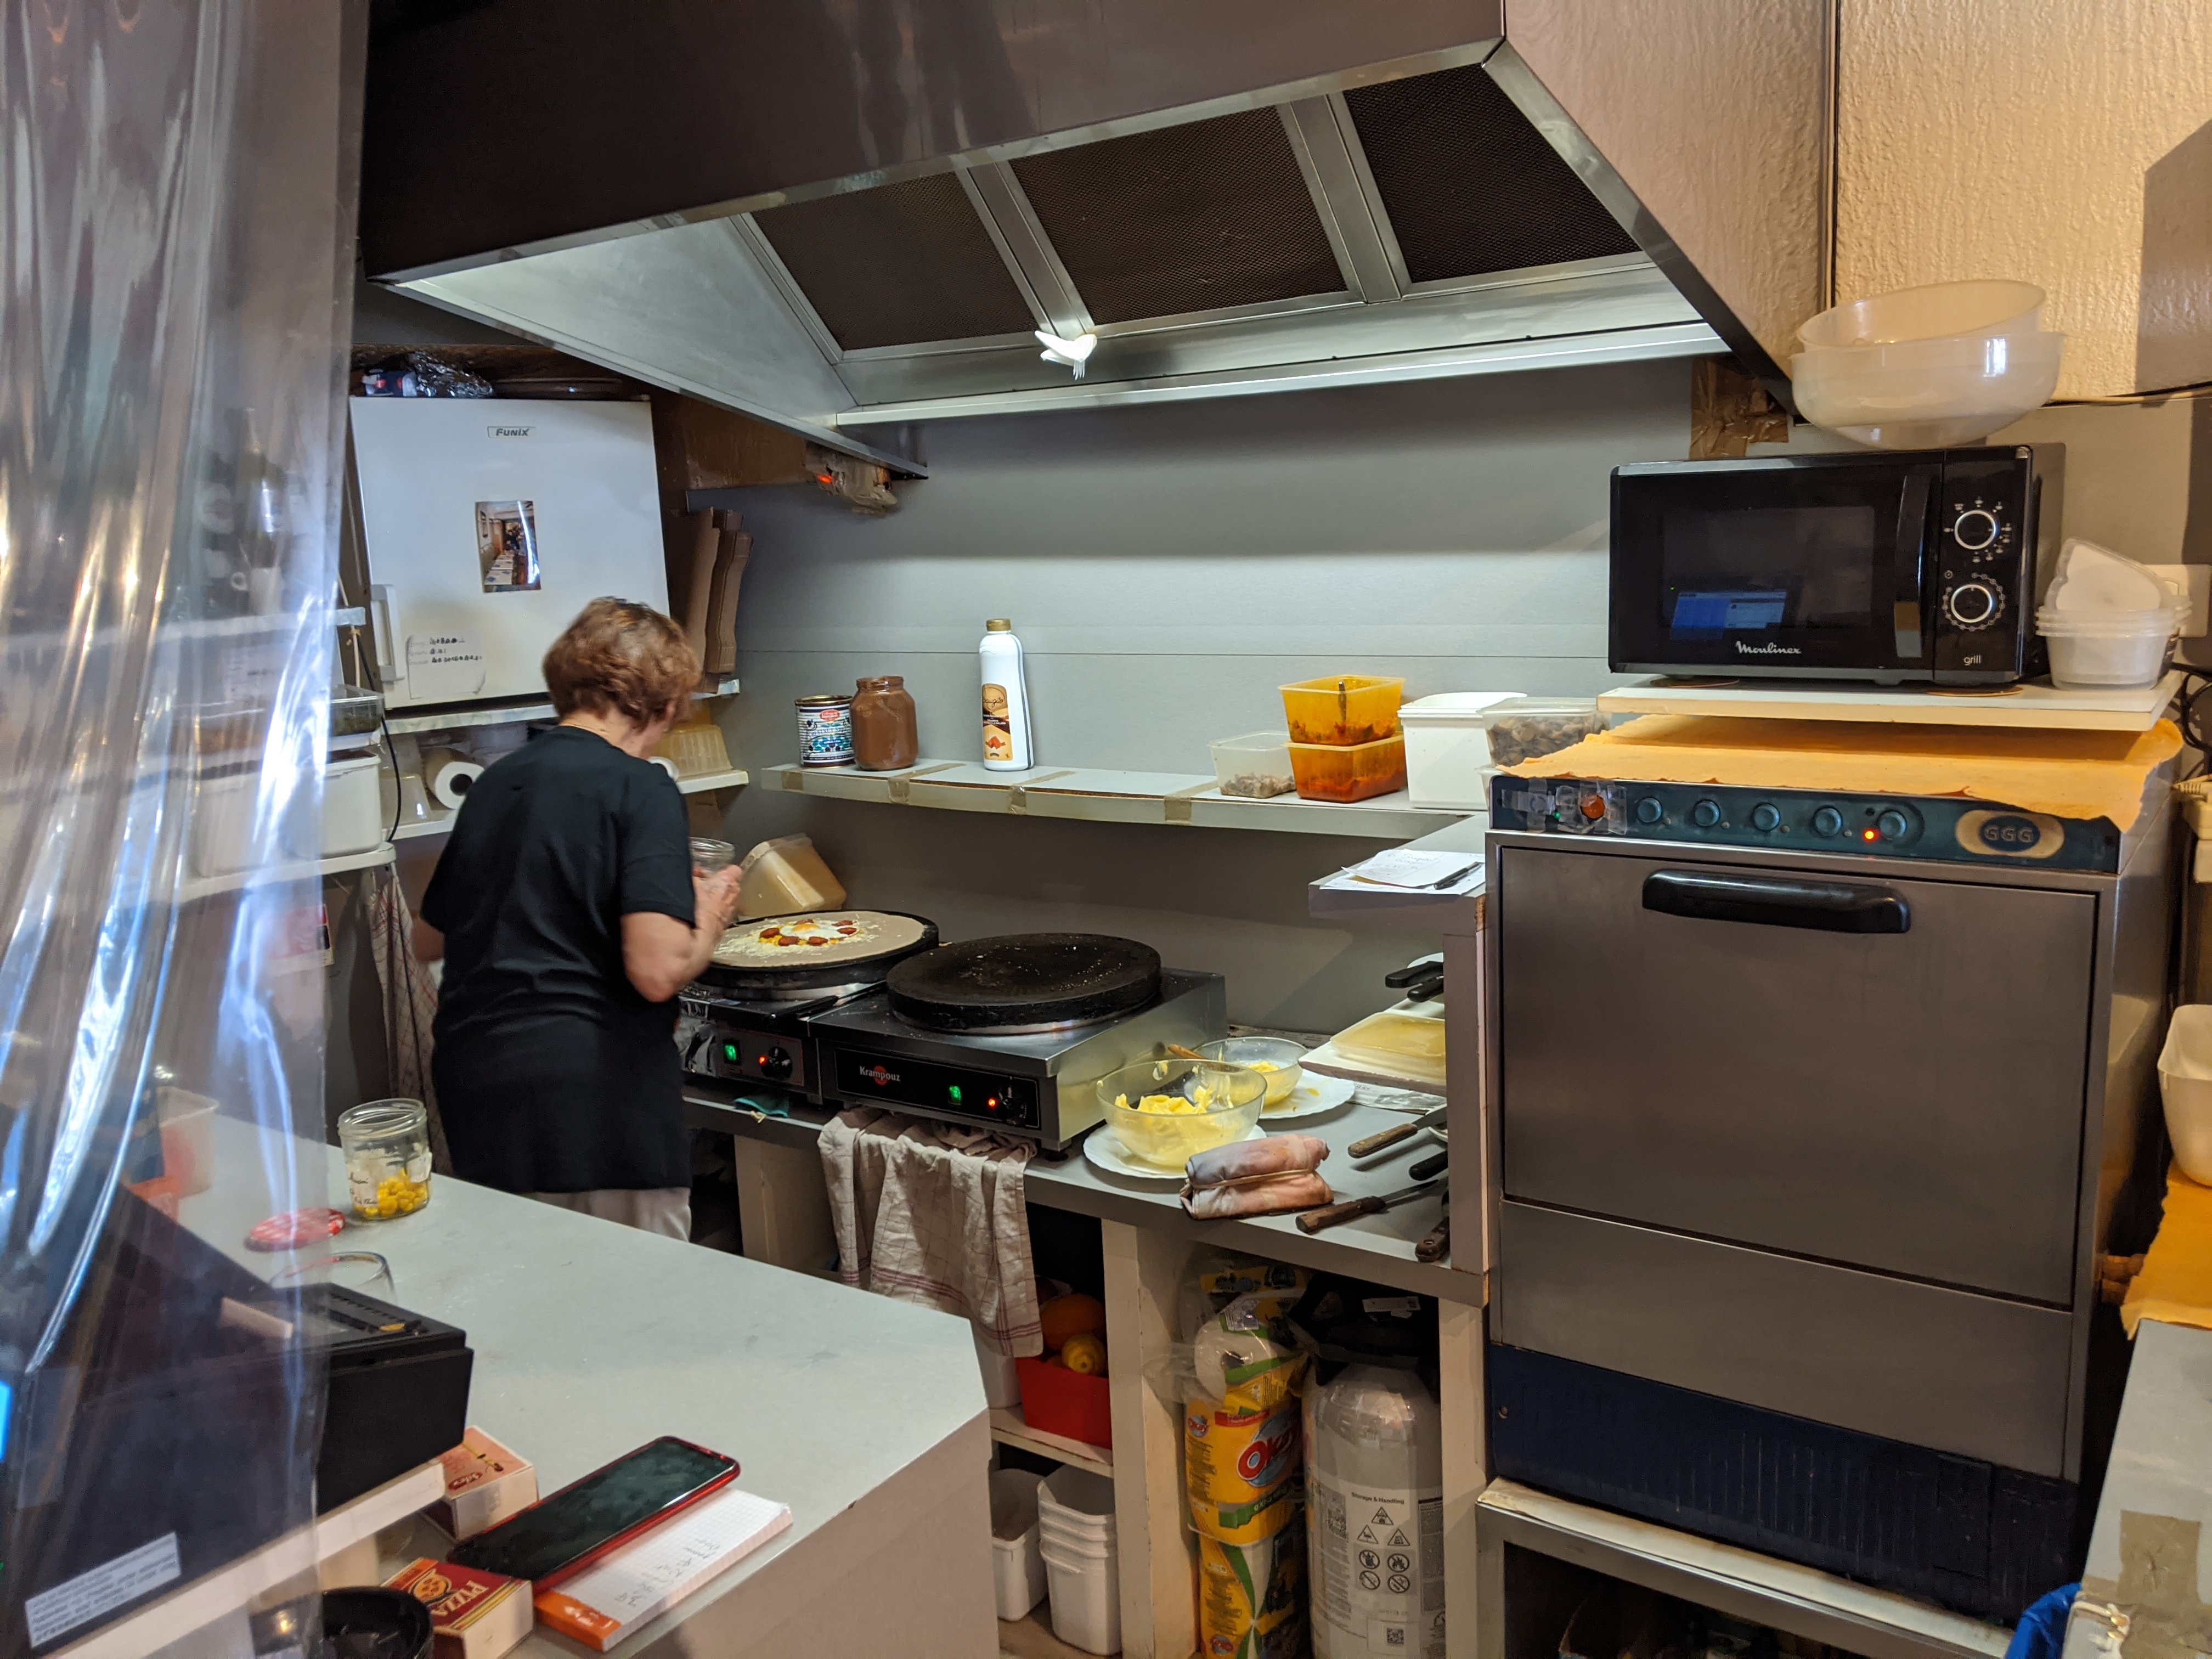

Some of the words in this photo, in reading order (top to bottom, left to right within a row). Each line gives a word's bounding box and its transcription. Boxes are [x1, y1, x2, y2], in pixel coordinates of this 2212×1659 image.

[1735, 640, 1802, 654] Moulinex
[1963, 654, 1982, 666] grill
[1983, 825, 2033, 843] GGG
[859, 1065, 901, 1082] Krampouz
[431, 1579, 489, 1617] PIZZA
